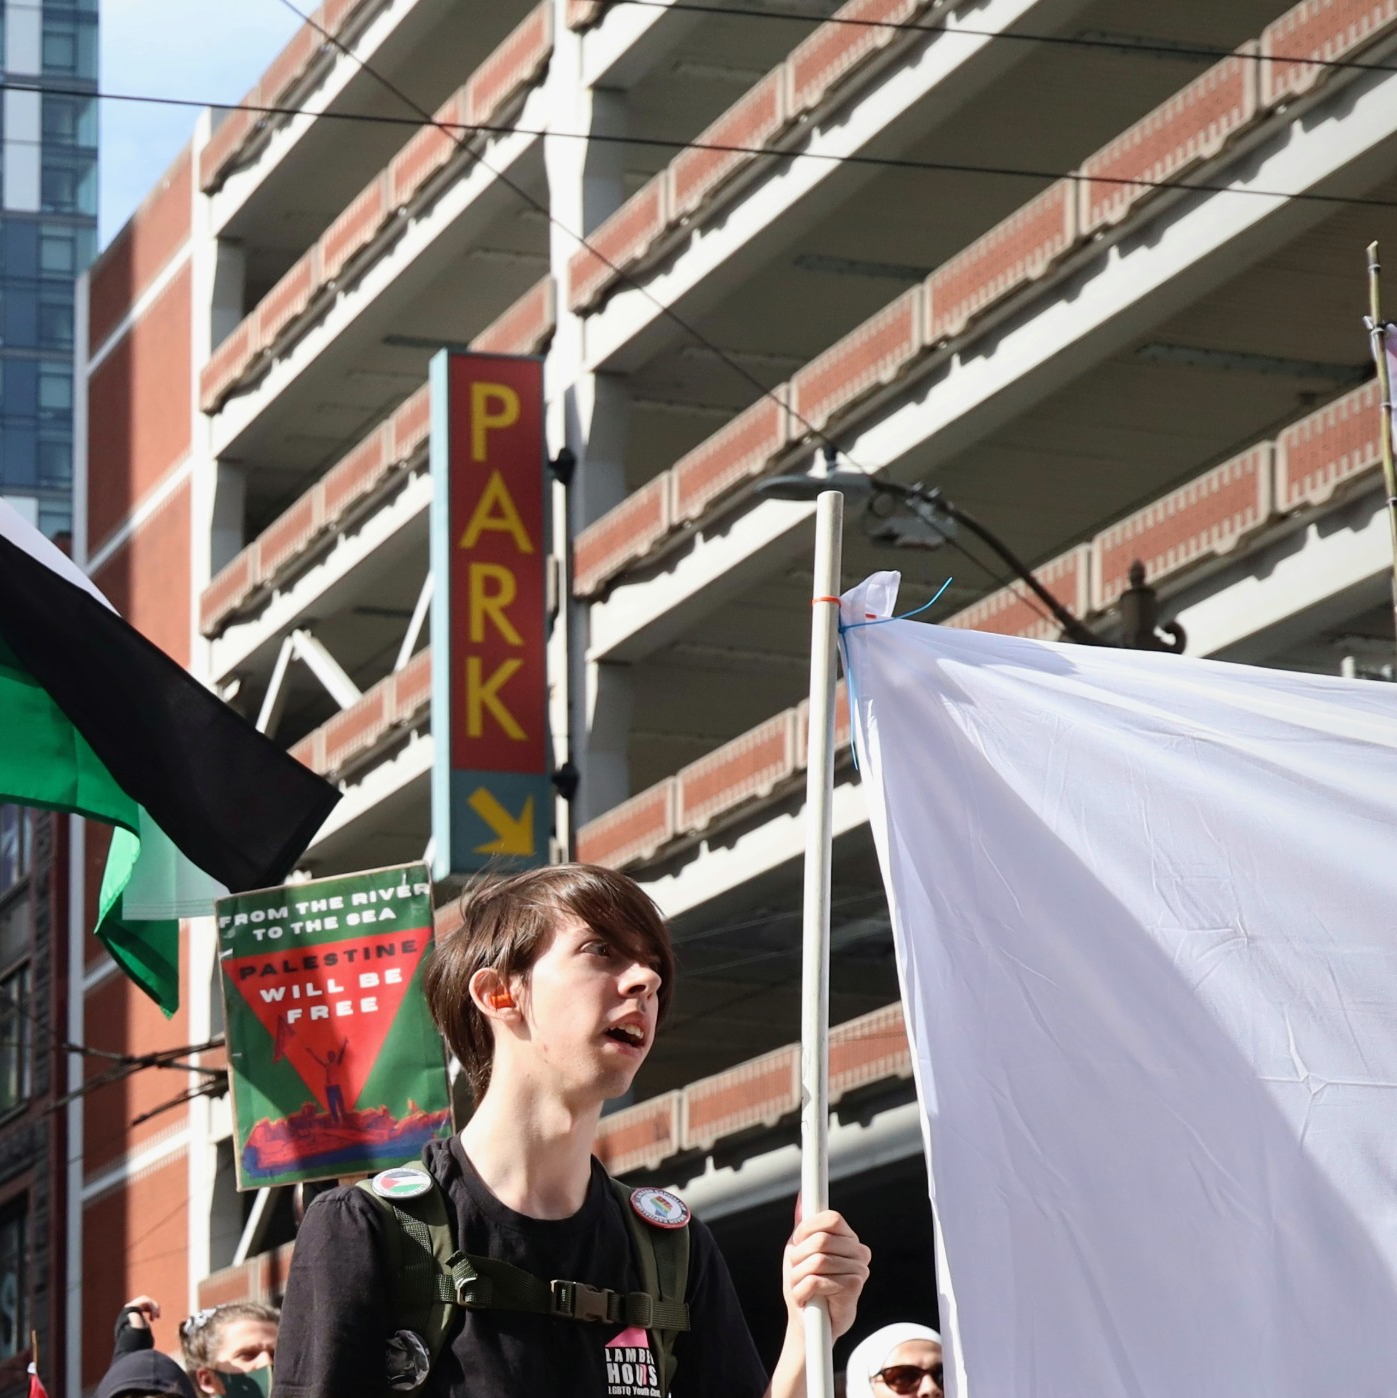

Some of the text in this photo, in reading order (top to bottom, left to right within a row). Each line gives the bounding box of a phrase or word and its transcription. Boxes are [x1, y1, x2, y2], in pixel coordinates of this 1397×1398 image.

[459, 381, 535, 741] PARK
[219, 881, 430, 928] FROM THE RIVER
[253, 907, 397, 941] TO THE SEA
[239, 939, 419, 981] PALESTINE
[259, 967, 403, 1004] WILL BE
[286, 997, 378, 1025] FREE
[608, 1386, 631, 1396] LGBTQ
